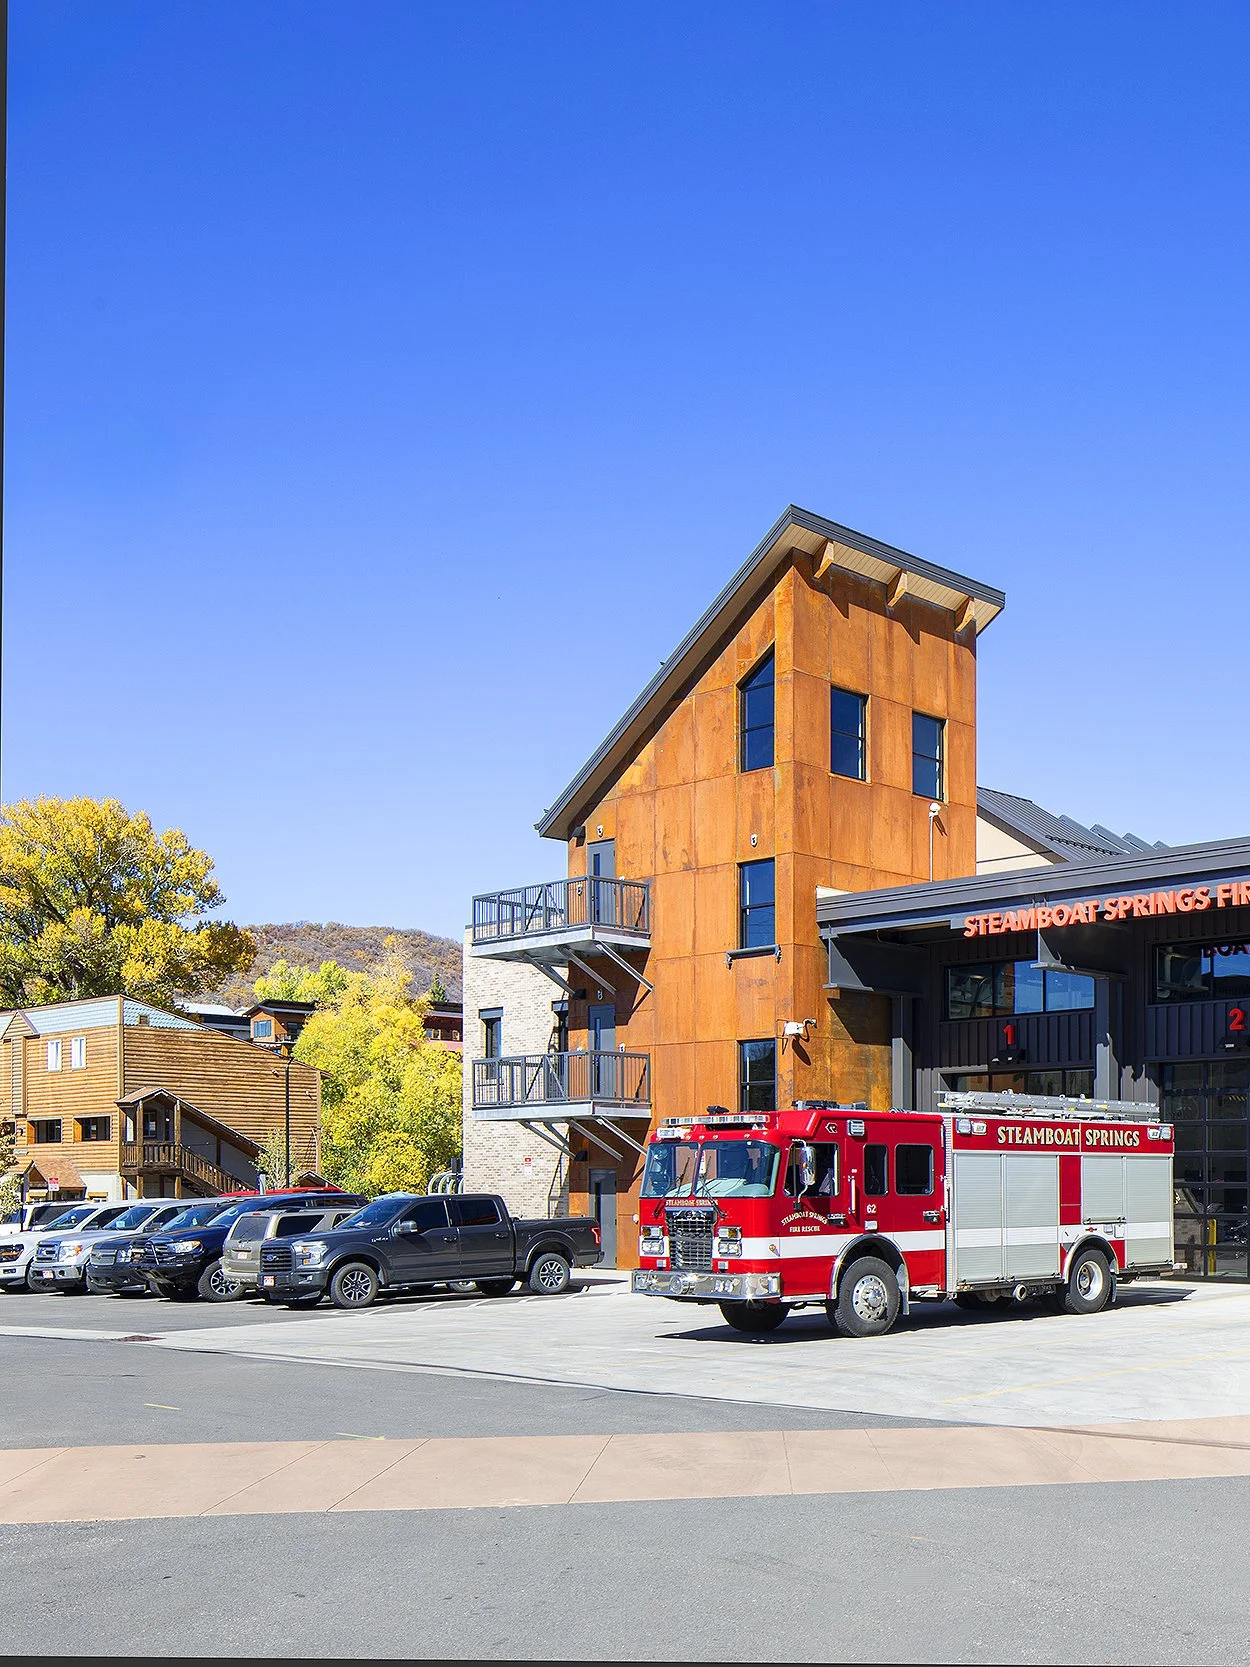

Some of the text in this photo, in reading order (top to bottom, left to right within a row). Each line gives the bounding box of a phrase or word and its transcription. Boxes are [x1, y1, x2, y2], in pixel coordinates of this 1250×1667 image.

[963, 899, 1101, 937] STEAMBOAT
[1103, 886, 1211, 920] SPRINGS
[1228, 1007, 1245, 1031] 2
[1003, 1024, 1015, 1045] 1
[997, 1125, 1140, 1147] STEAMBOAT SPRINGS
[781, 1211, 828, 1226] STEAMBOAT SPRINGS
[866, 1203, 877, 1214] 62
